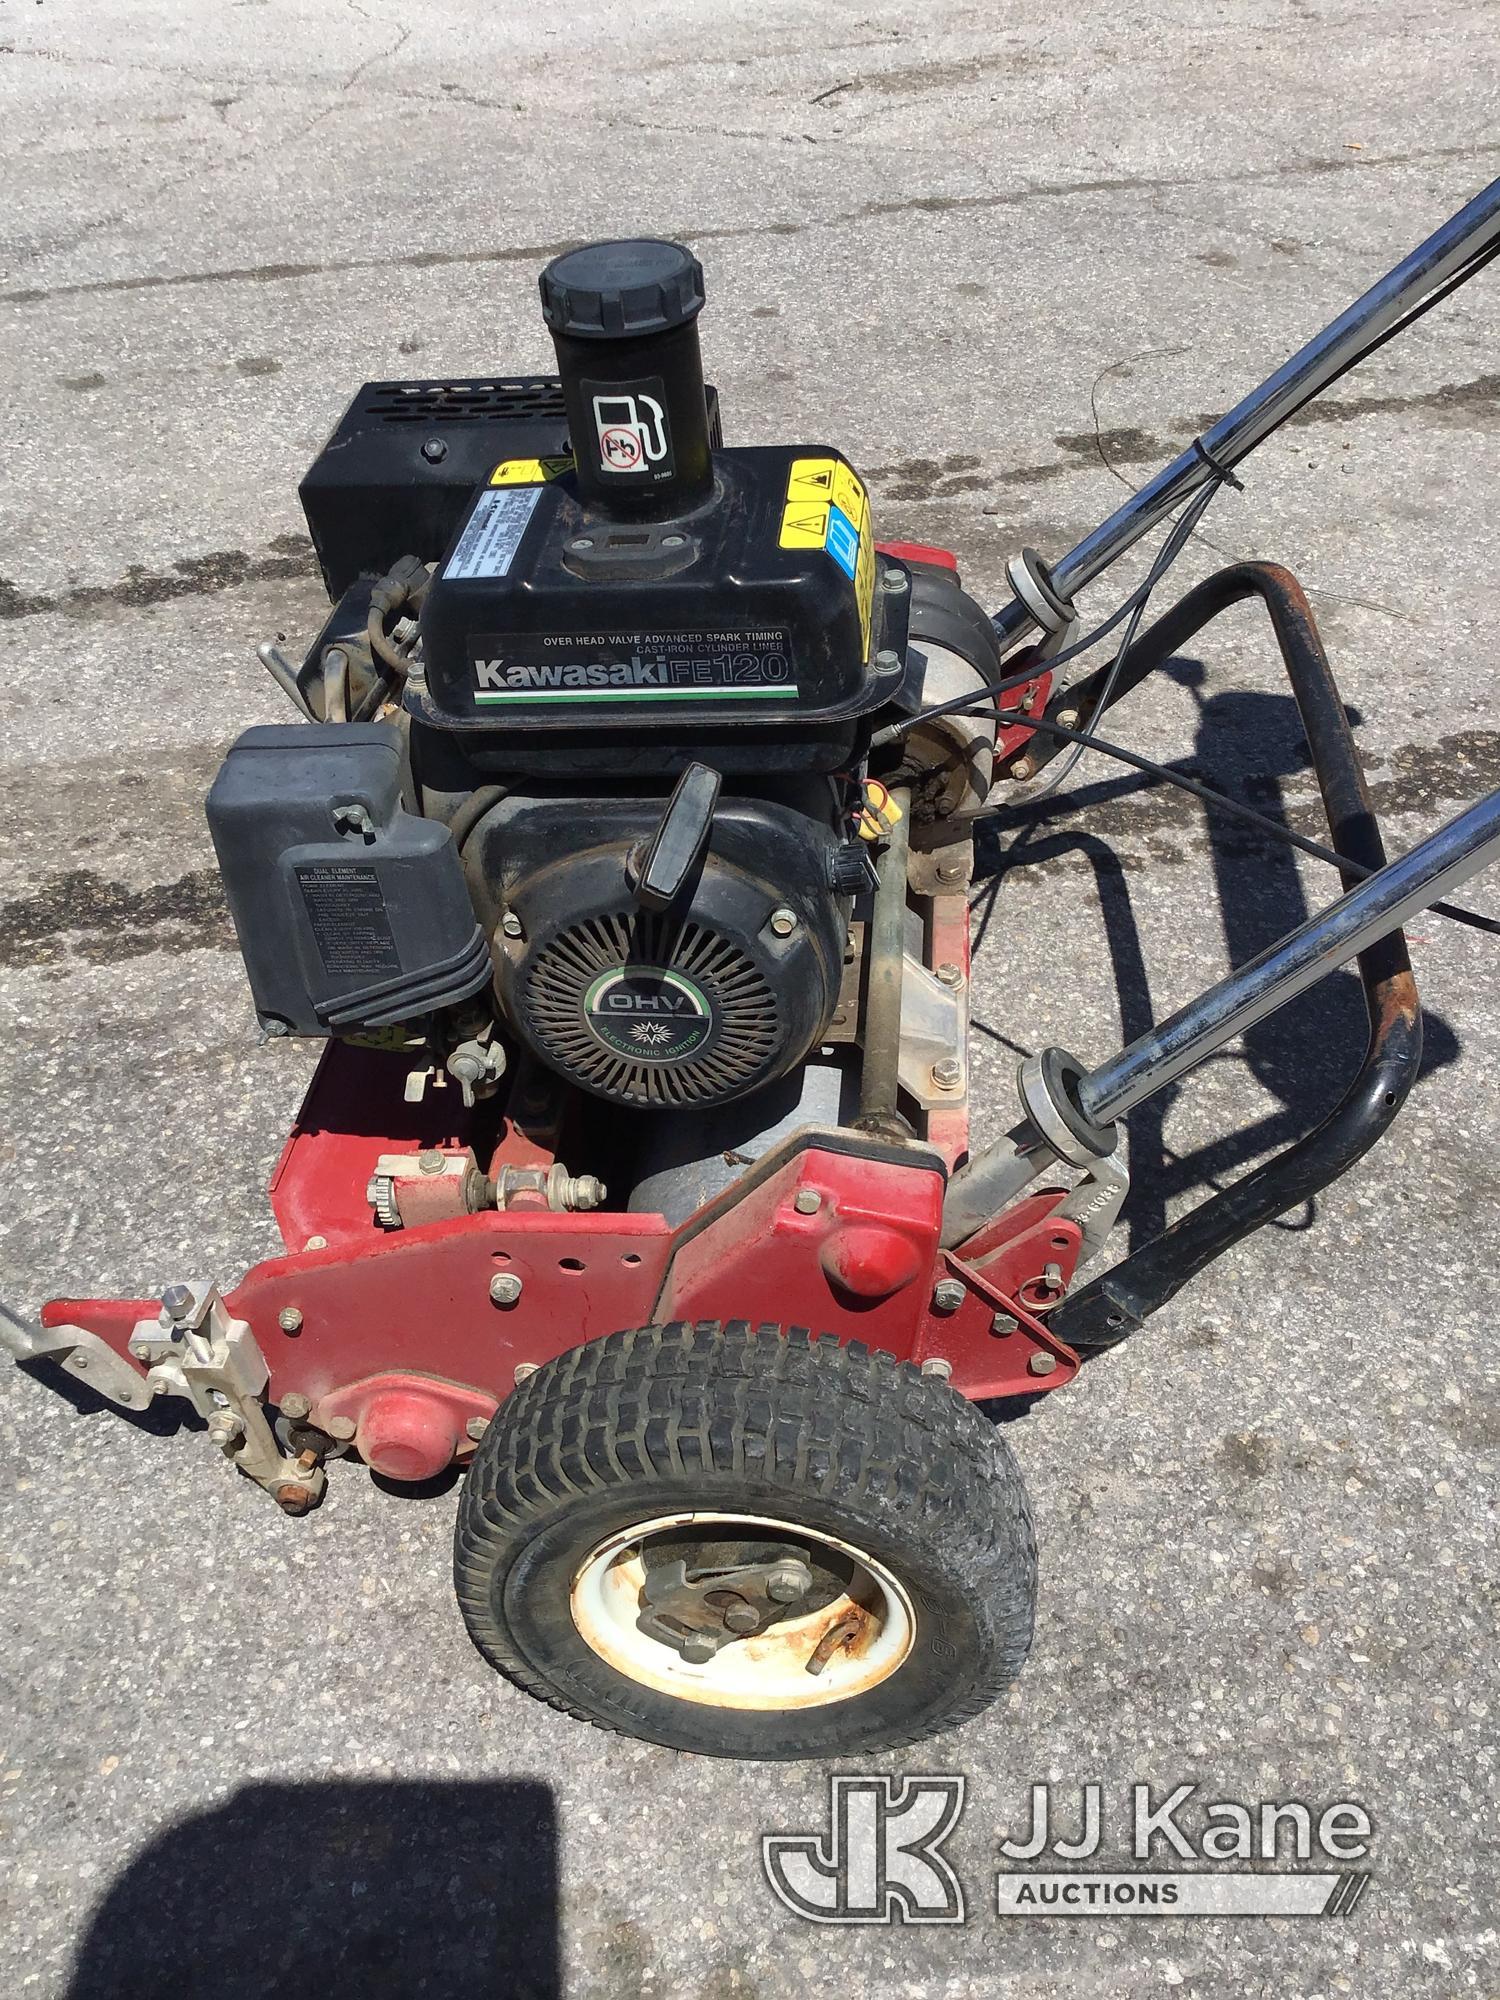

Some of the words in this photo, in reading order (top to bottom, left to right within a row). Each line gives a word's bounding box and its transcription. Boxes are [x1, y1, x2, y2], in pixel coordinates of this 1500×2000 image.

[544, 637, 572, 647] OVER
[576, 636, 605, 646] HEAD
[608, 635, 641, 645] VALVE
[645, 634, 702, 644] ADVANCED
[706, 632, 741, 642] SPARK
[745, 631, 783, 641] TIMING
[636, 645, 693, 654] CAST-IRON
[697, 643, 749, 653] CYLINDER
[753, 642, 784, 651] LINER
[474, 655, 669, 688] Kawasaki
[669, 653, 790, 684] FE120
[608, 994, 685, 1010] OHV
[600, 1024, 661, 1056] ELECTRONIC
[664, 1030, 701, 1055] IGNITION
